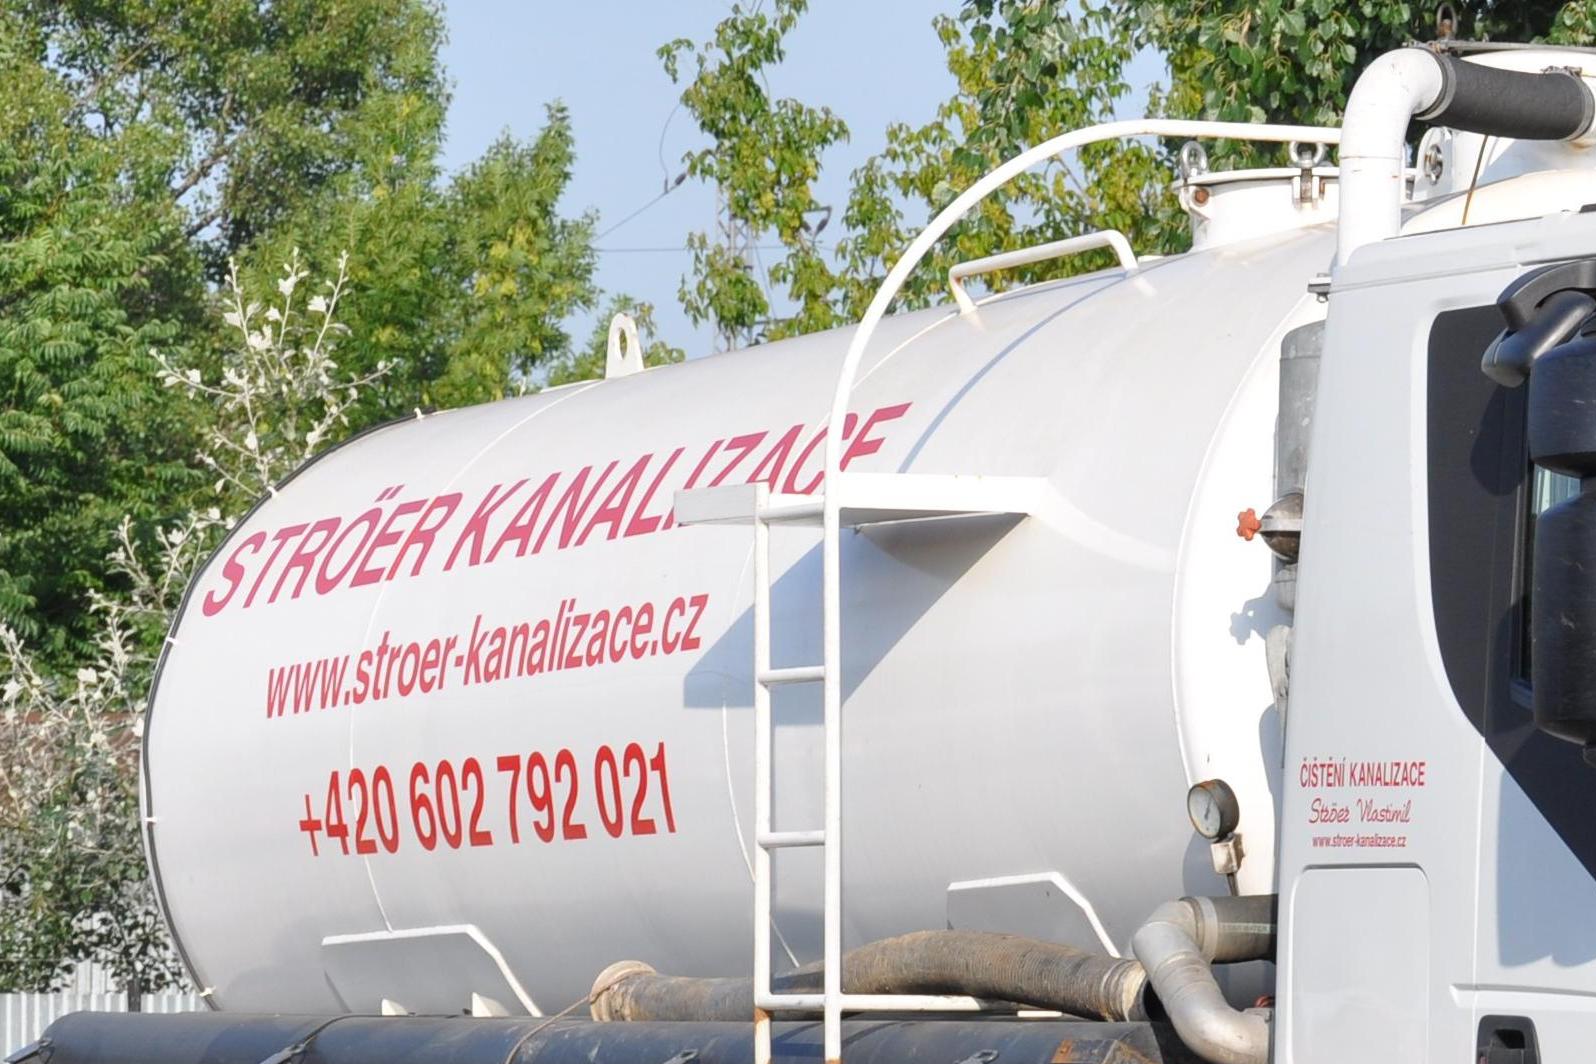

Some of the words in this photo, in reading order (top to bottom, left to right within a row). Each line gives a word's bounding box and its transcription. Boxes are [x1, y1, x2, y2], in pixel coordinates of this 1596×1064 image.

[202, 485, 463, 617] STRÖER
[266, 593, 710, 719] www.stroer-kanalizace.cz
[299, 764, 400, 857] +420
[409, 757, 494, 852] 602
[496, 748, 588, 844] 792
[595, 741, 677, 838] 021
[1300, 756, 1346, 788] ČIŠTĚNÍ
[1349, 761, 1426, 787] KANALIZACE
[1308, 798, 1350, 824] Ströer
[1356, 798, 1412, 823] Vlastimil
[1312, 833, 1407, 848] www.stroer-kanalizace.cz
